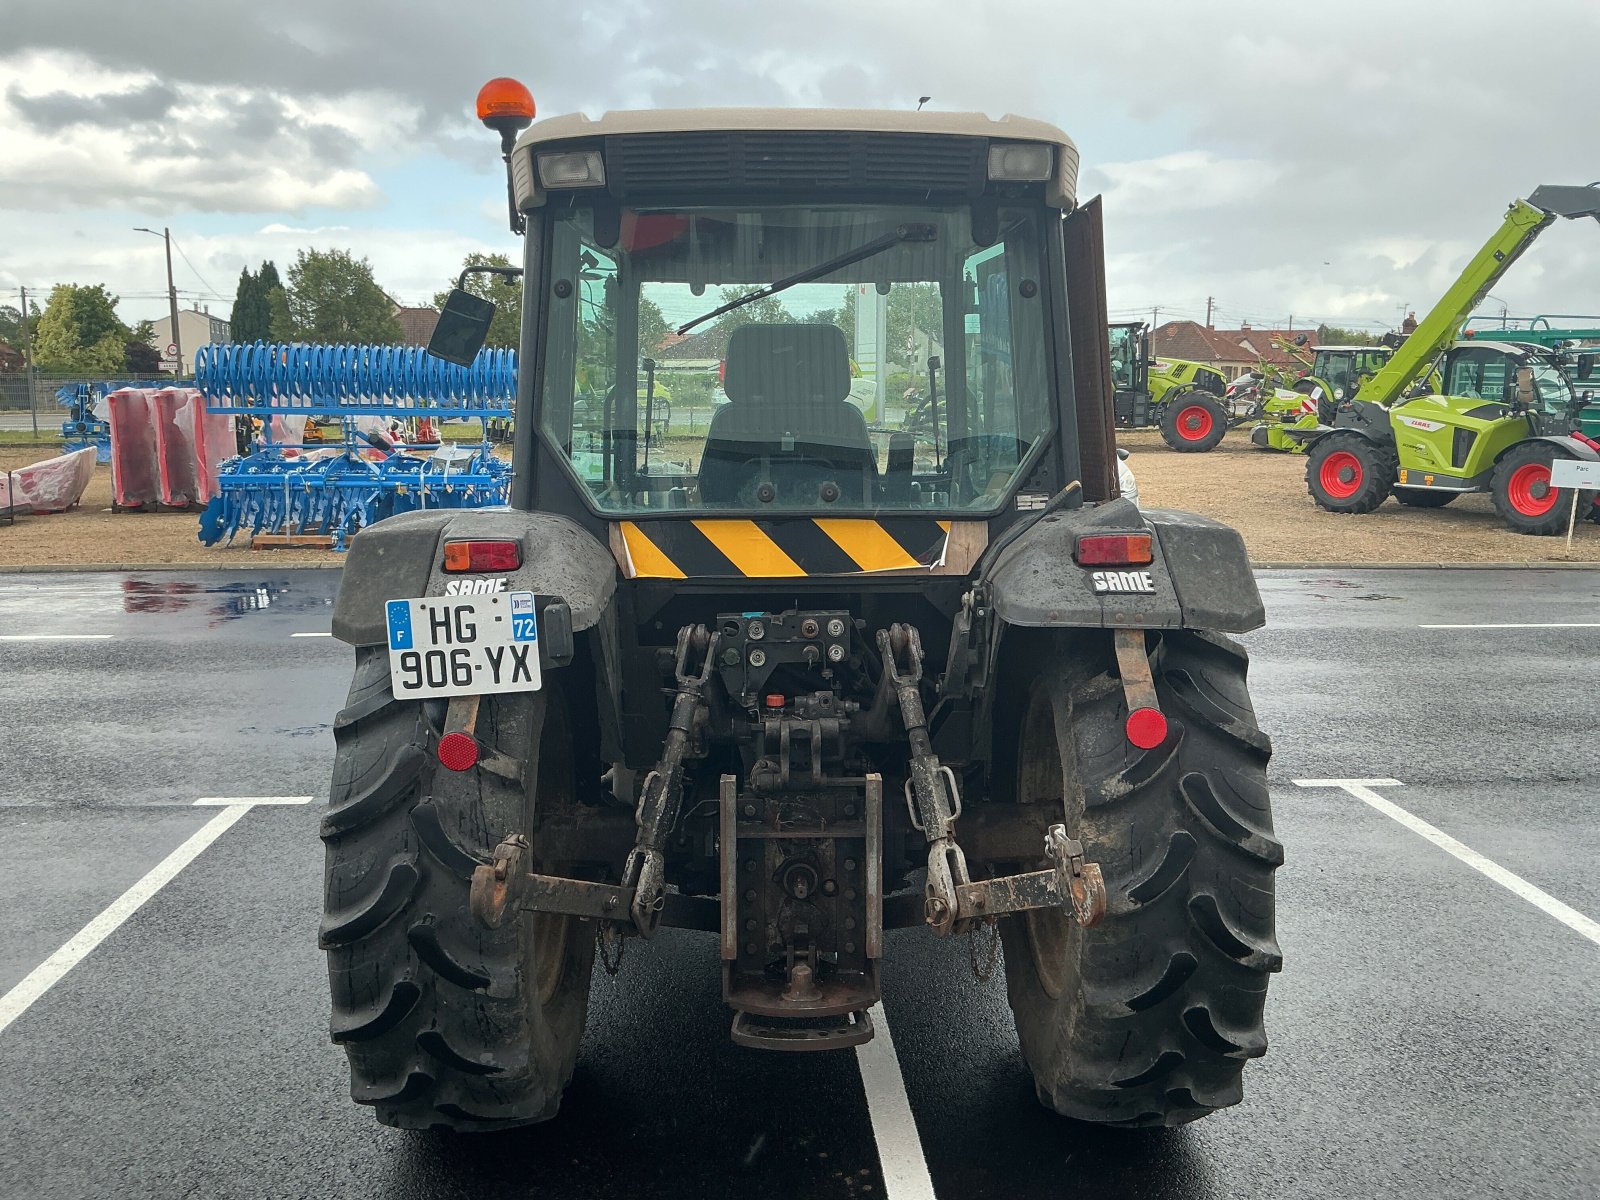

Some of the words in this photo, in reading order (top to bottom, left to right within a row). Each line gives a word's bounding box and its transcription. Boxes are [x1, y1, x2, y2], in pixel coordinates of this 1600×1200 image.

[1411, 420, 1431, 429] CLAAS
[445, 578, 508, 597] SAME
[1092, 571, 1155, 592] SAME
[429, 604, 477, 645] HG
[513, 618, 535, 638] 72
[396, 630, 405, 642] F
[400, 644, 532, 690] 906-YX
